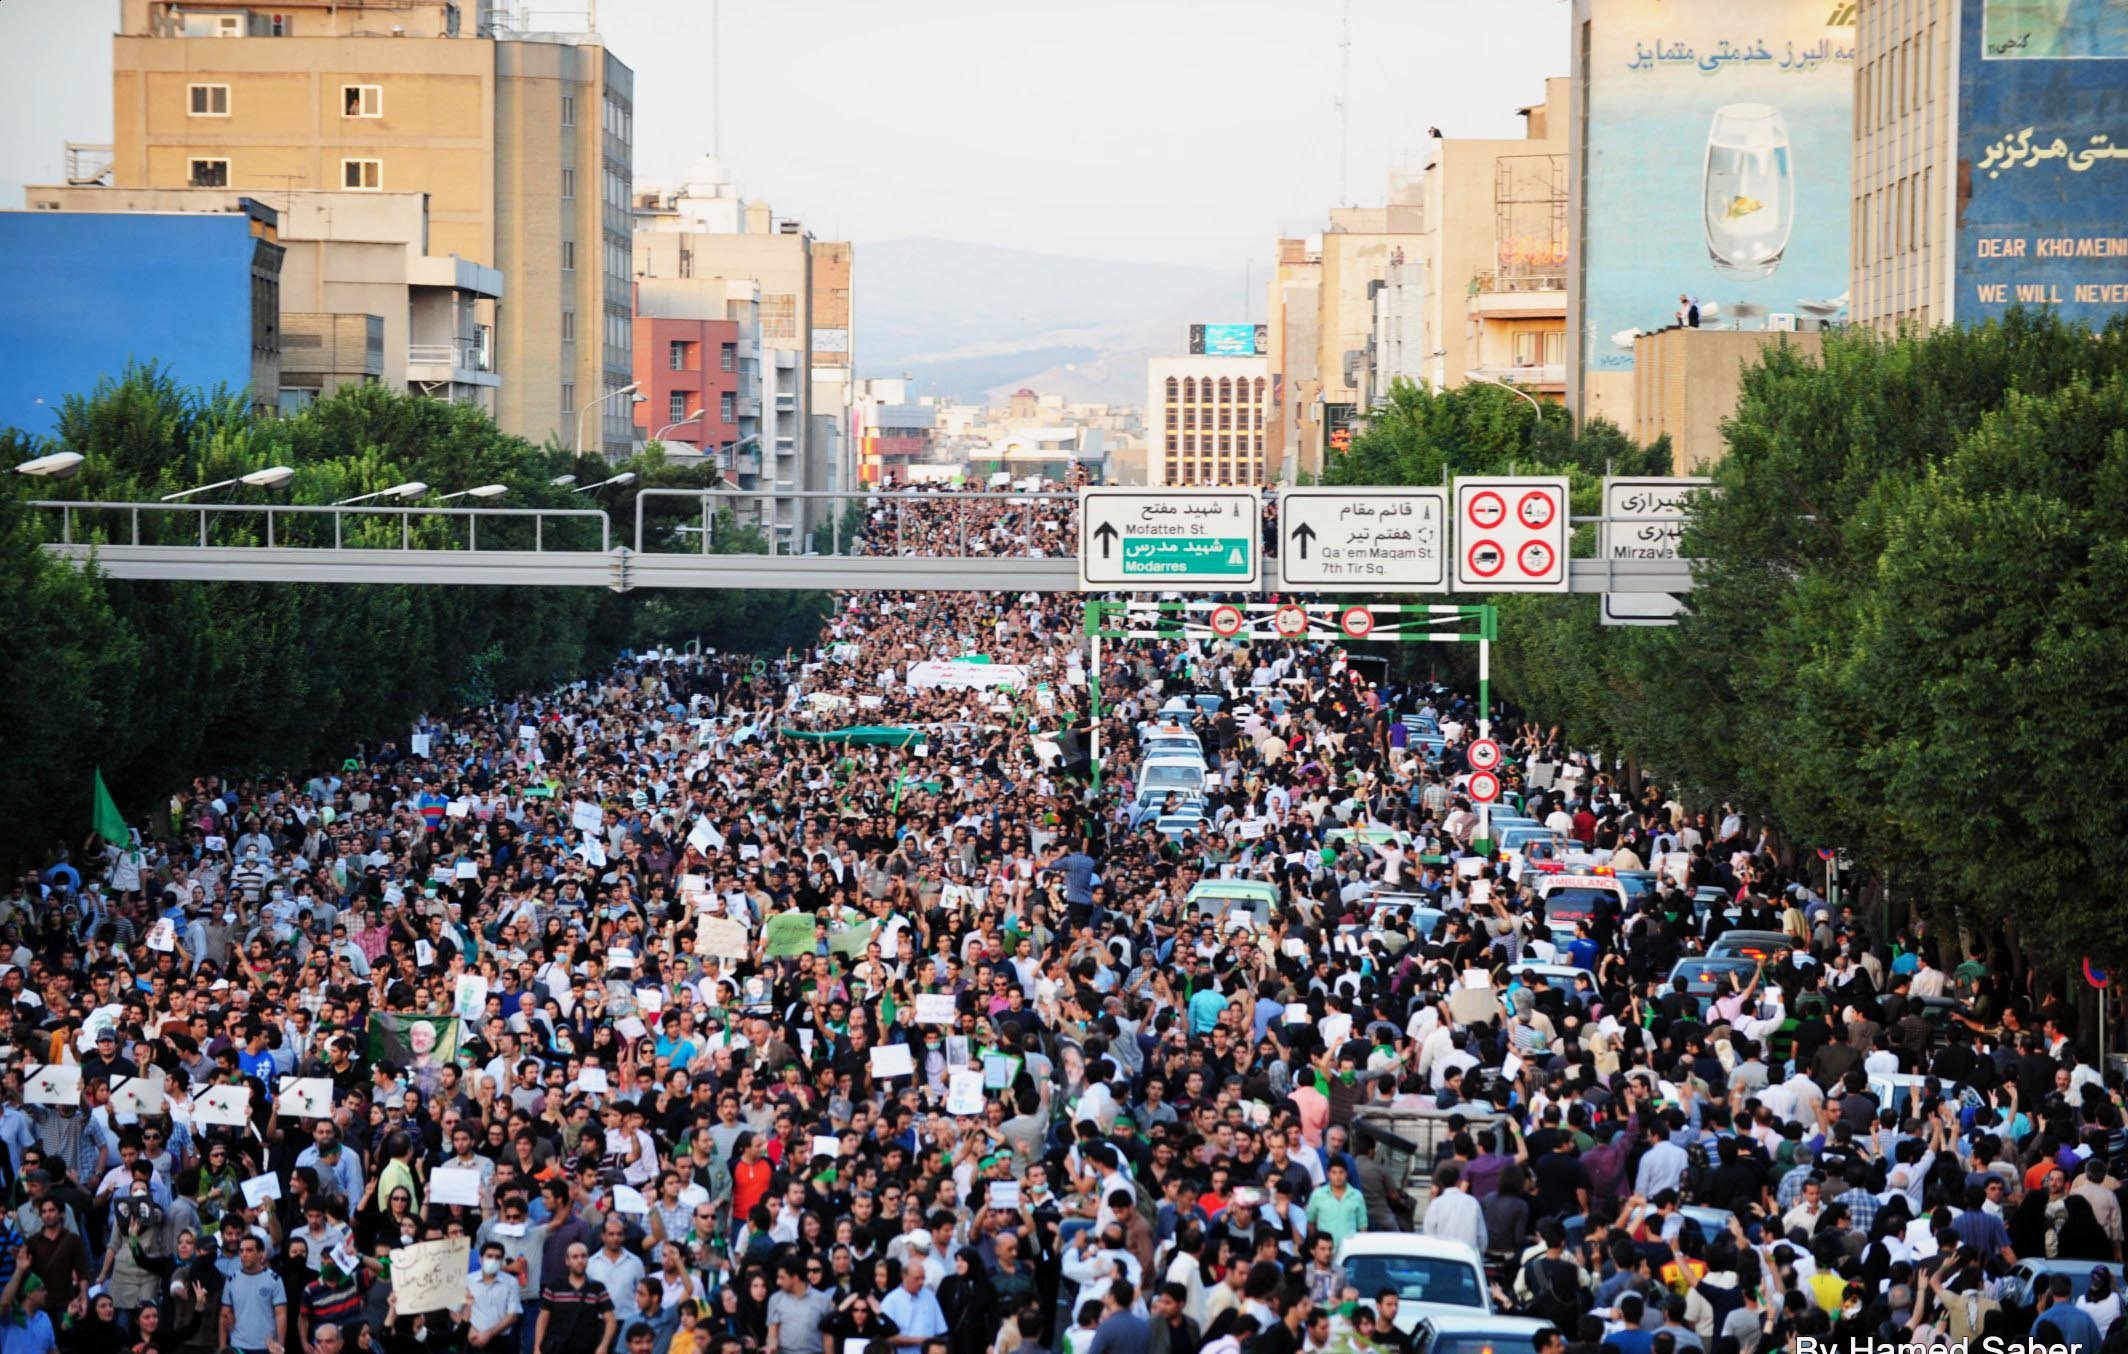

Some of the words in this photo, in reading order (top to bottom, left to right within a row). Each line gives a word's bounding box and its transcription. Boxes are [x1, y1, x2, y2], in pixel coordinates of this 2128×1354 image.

[1627, 38, 1695, 70] متمایز
[1698, 39, 1773, 71] خدمتی
[1778, 38, 1829, 69] البرز
[1977, 238, 2026, 257] DEAR
[2036, 237, 2128, 257] KHOMEINI
[1977, 284, 2009, 303] WE
[2016, 284, 2064, 303] WILL
[1141, 502, 1177, 520] مفتح
[1183, 501, 1222, 518] شهید
[1340, 503, 1375, 521] مقام
[1379, 502, 1412, 523] قائم
[1125, 524, 1184, 535] Mofatteh
[1190, 524, 1208, 535] St.
[1346, 527, 1370, 544] تیر
[1374, 527, 1412, 546] هفتم
[1126, 541, 1178, 557] مدرس
[1183, 539, 1224, 556] شهید
[1370, 548, 1416, 560] Maqam
[1418, 547, 1434, 558] St.
[1125, 560, 1187, 572] Modarres
[1321, 563, 1343, 574] 7th
[1347, 563, 1364, 574] Tir
[1366, 563, 1387, 575] Sq.
[1547, 877, 1619, 889] AMBULANCE
